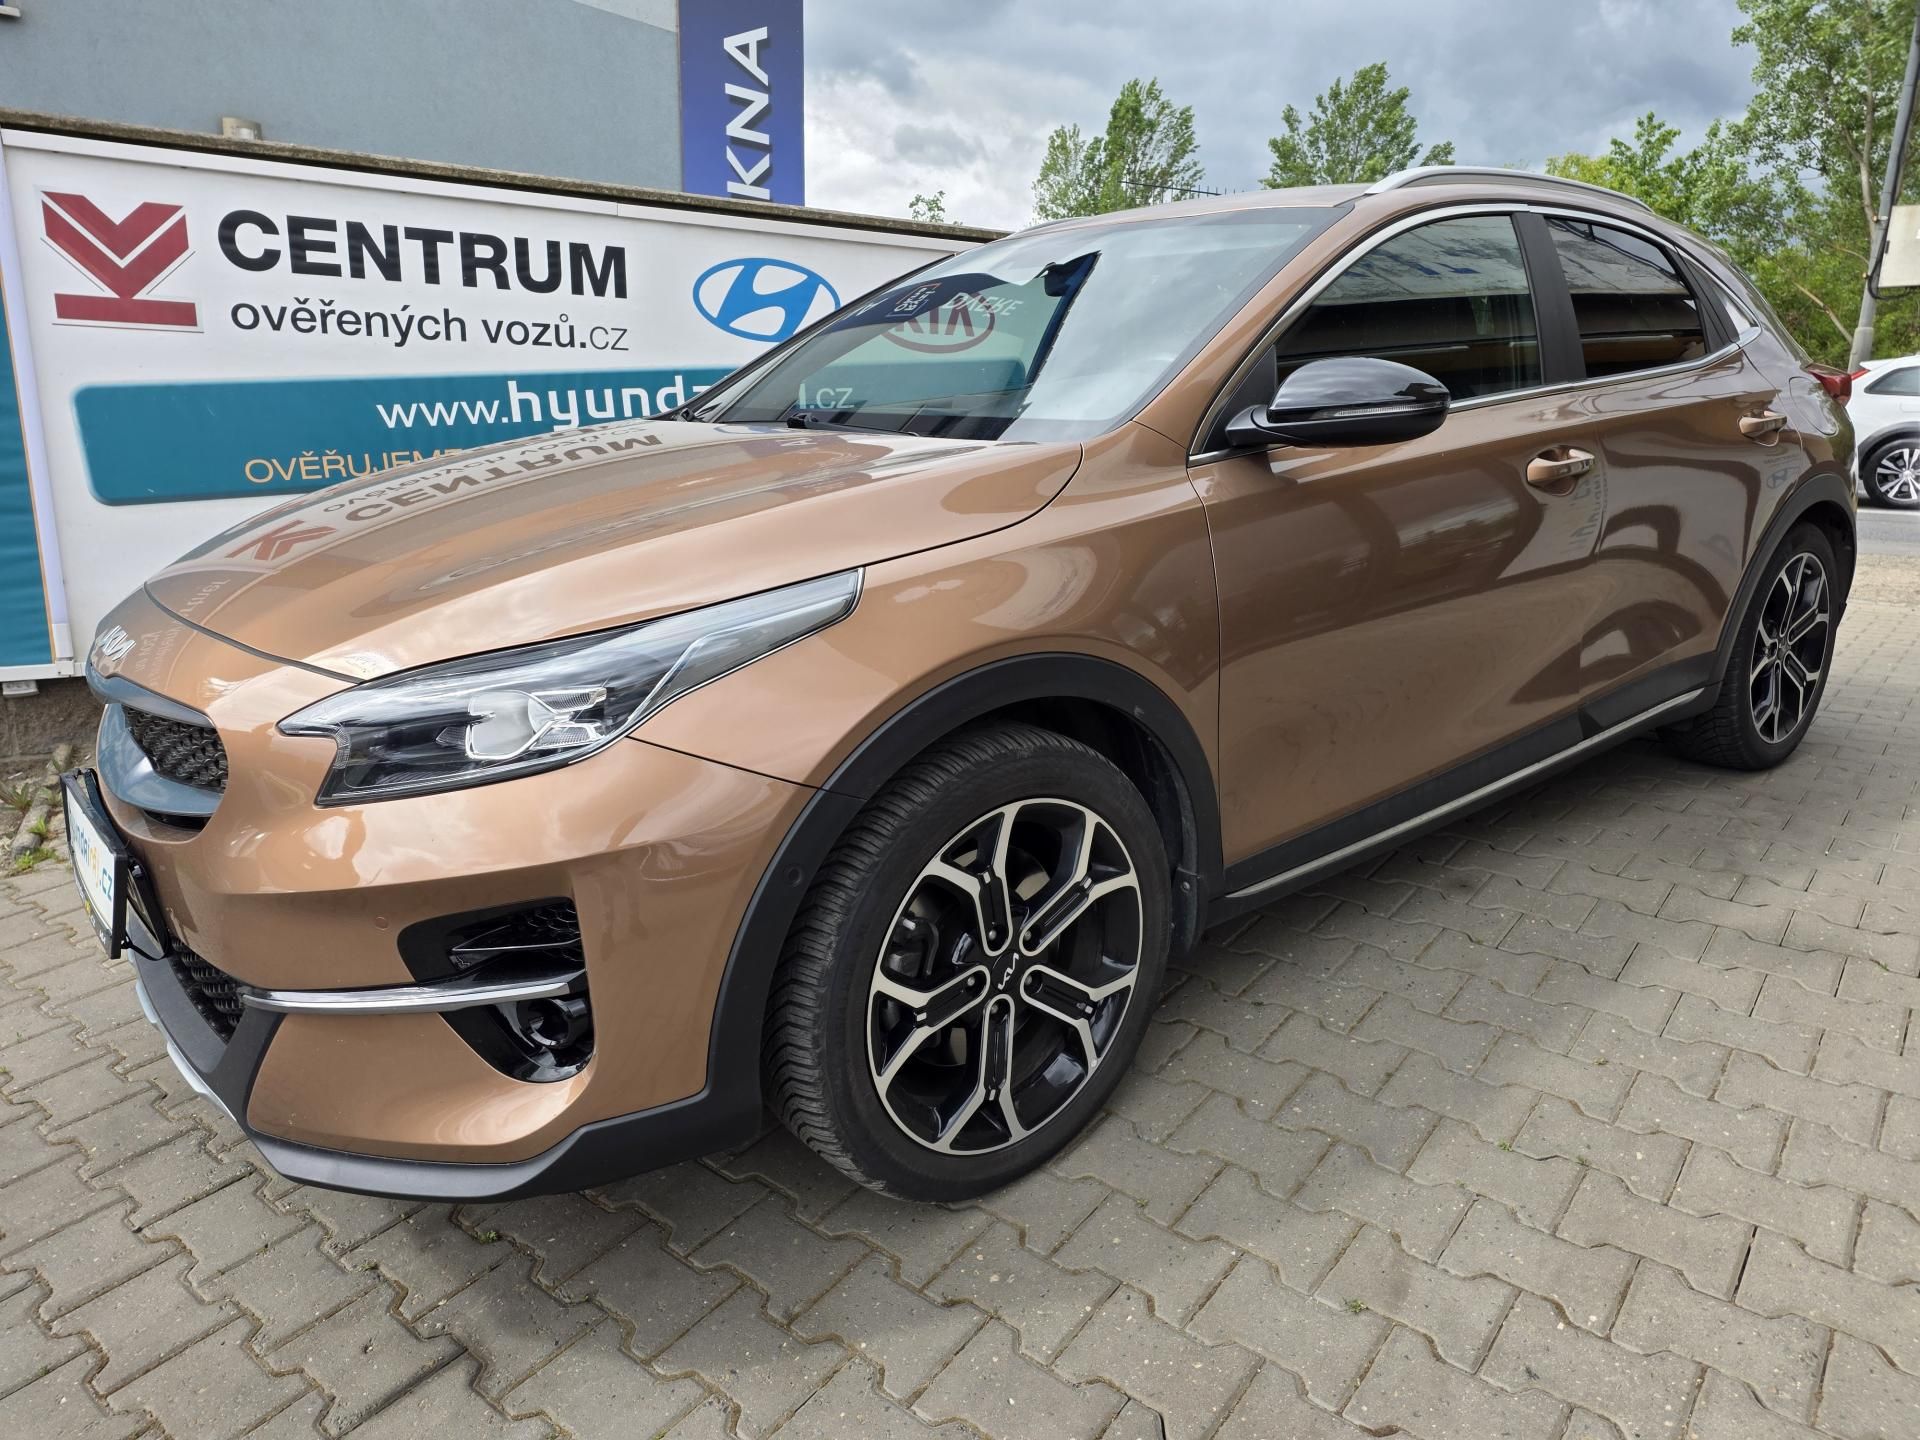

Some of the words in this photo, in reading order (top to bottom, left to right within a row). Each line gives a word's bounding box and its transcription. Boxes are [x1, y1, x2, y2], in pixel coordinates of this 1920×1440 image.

[218, 209, 628, 299] CENTRUM
[231, 297, 467, 347] ověřených
[481, 313, 629, 351] vozů.cz
